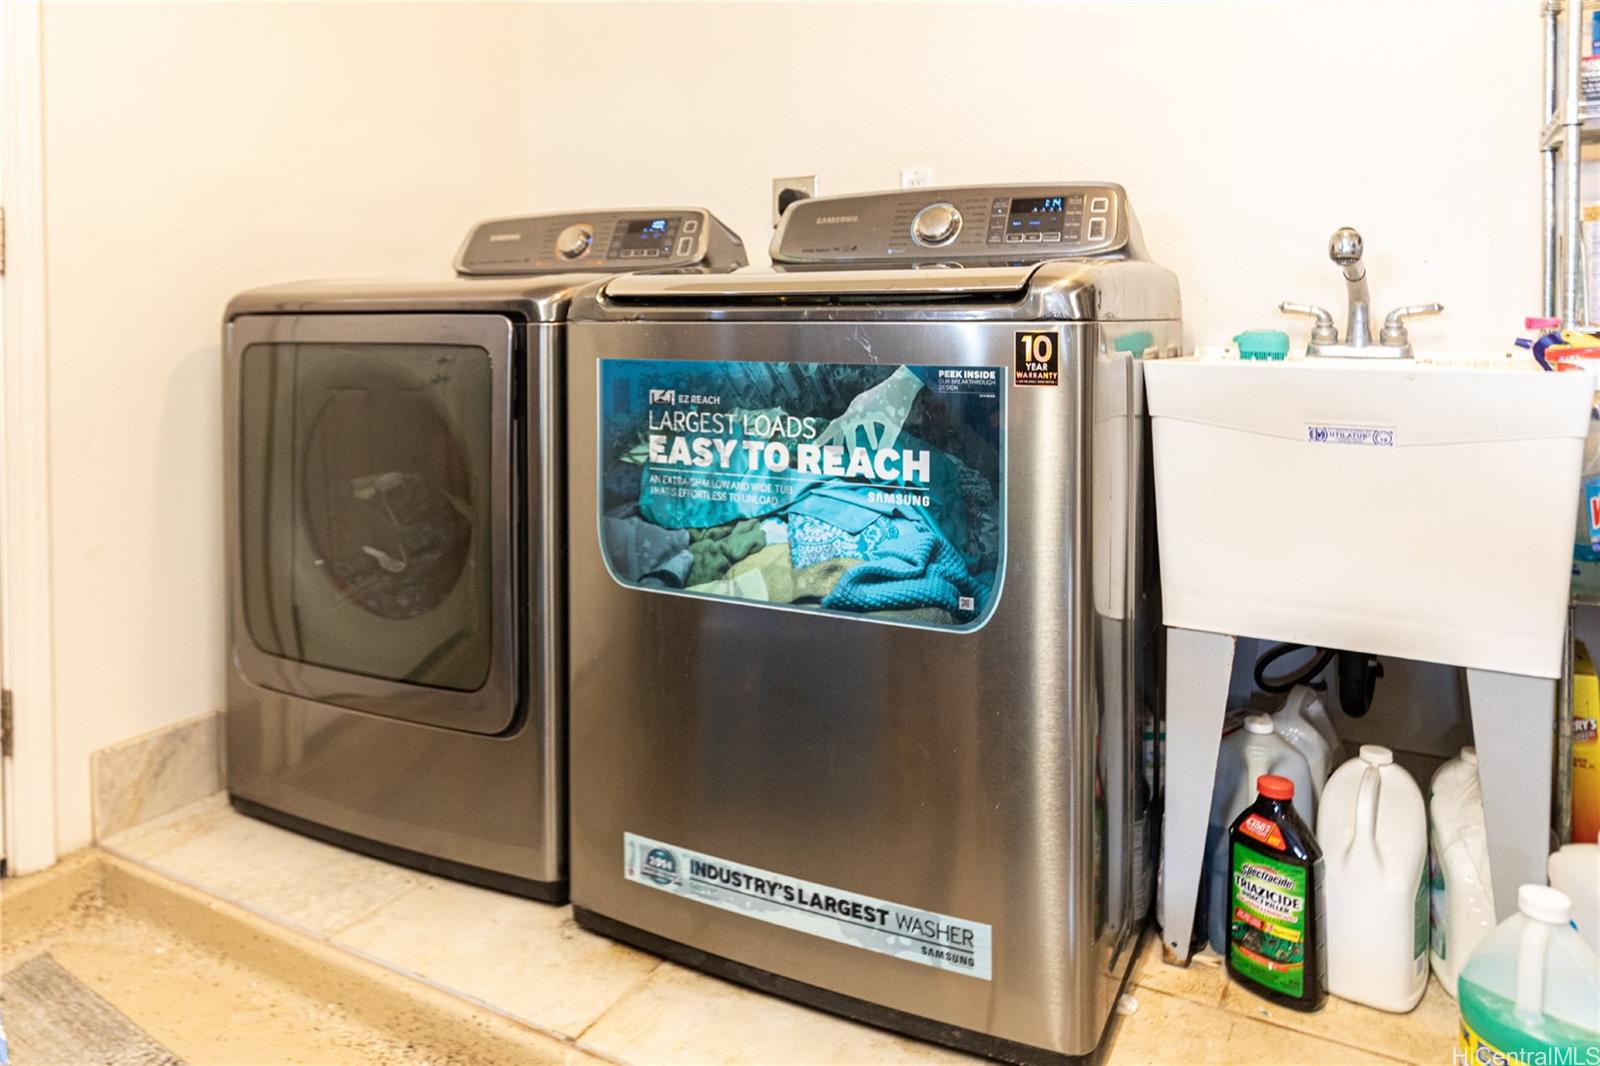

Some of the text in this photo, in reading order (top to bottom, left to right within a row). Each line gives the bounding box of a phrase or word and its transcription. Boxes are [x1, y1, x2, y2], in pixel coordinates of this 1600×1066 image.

[816, 215, 858, 225] SAMSUNG
[1021, 335, 1052, 363] 10
[938, 369, 996, 379] PEEK INSIDE
[1016, 371, 1058, 379] WARRANTY
[1025, 362, 1048, 371] YEAR
[678, 394, 720, 405] EZ REACH
[649, 410, 816, 439] LARGEST LOADS
[649, 434, 930, 483] EASY TO REACH
[649, 475, 660, 483] AN
[730, 481, 749, 490] AND
[751, 482, 772, 493] WIDE
[775, 485, 793, 495] TUB
[678, 488, 727, 501] EFFORTLESS
[729, 492, 741, 503] TO
[867, 491, 930, 507] SAMSUNG
[1241, 864, 1293, 889] Spectracide
[1236, 875, 1300, 910] TRIAZICIDE
[690, 859, 795, 902] INDUSTRY'S
[797, 888, 889, 926] LARGEST
[895, 913, 975, 949] WASHER
[920, 945, 975, 967] SAMSUNG
